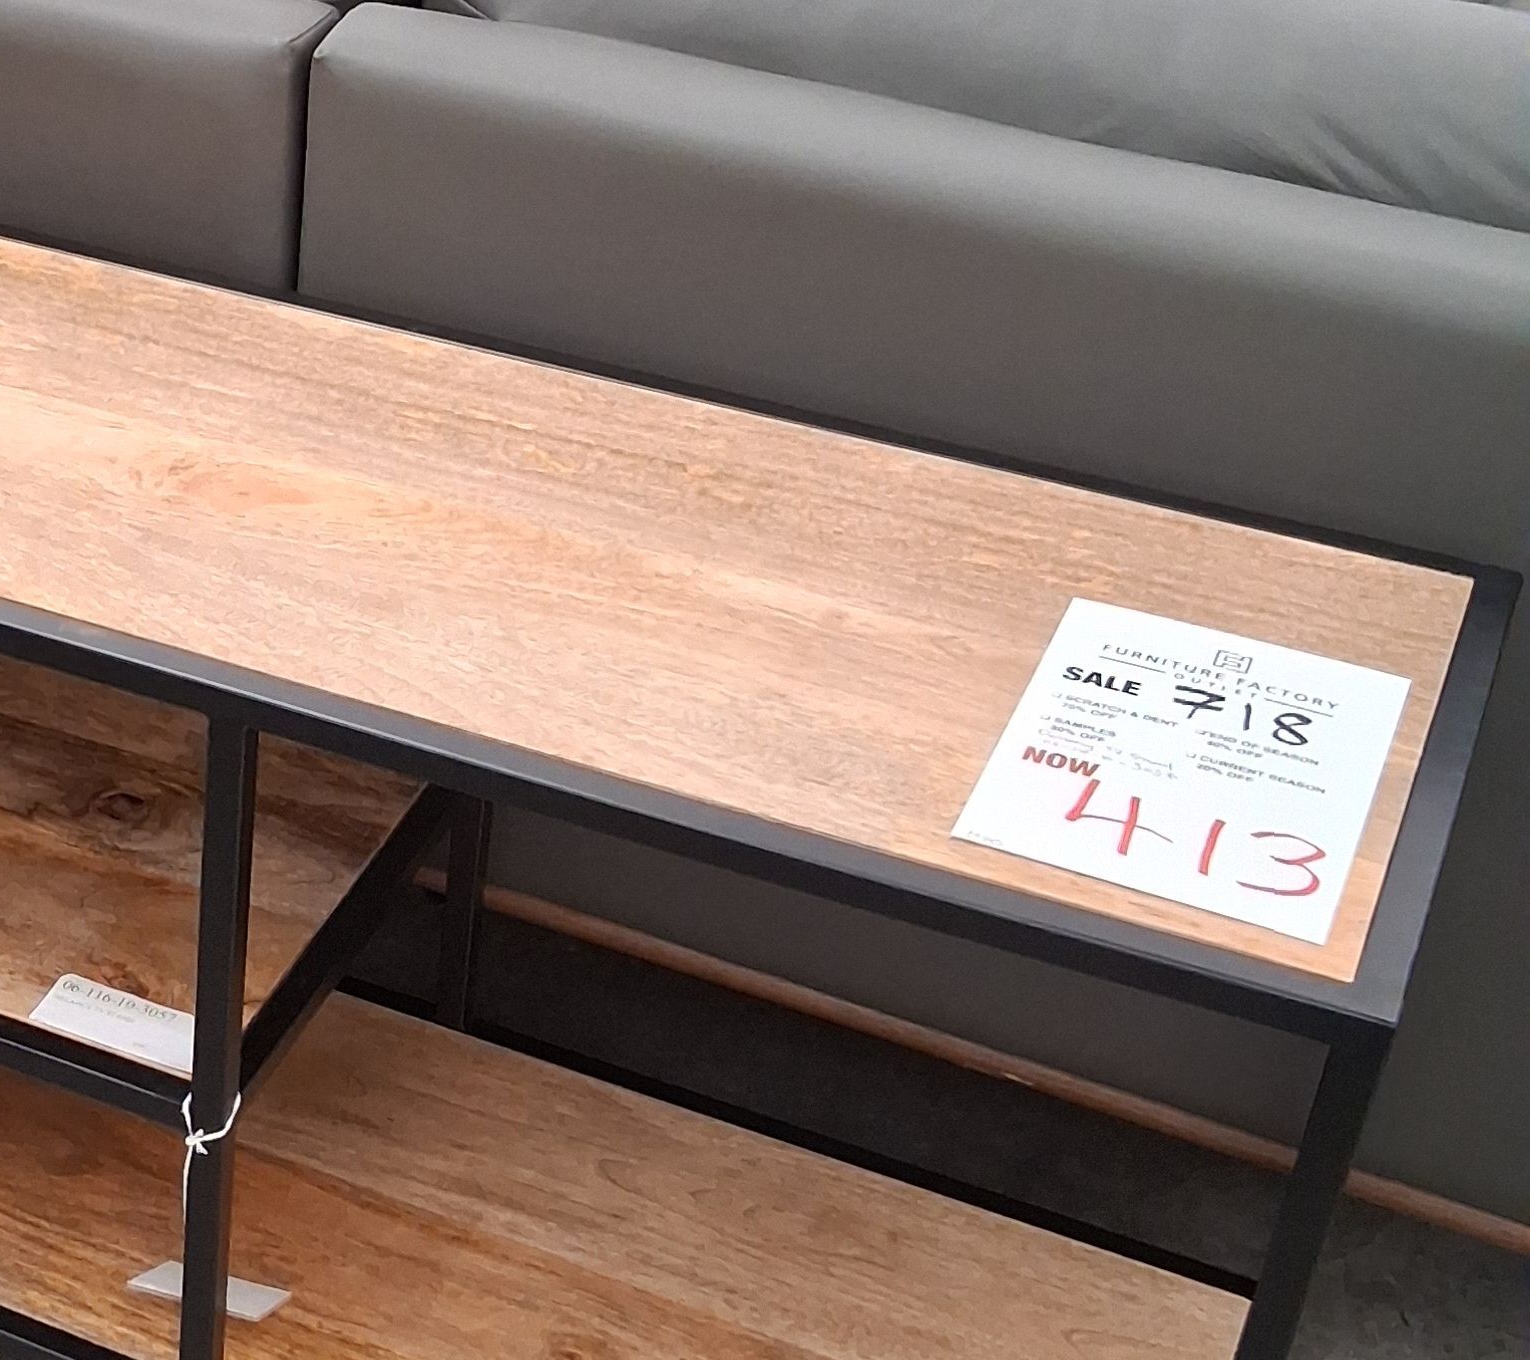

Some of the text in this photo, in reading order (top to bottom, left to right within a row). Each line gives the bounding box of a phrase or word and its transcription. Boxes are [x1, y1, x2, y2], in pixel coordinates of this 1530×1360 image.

[1062, 666, 1142, 696] SALE
[1102, 644, 1340, 710] FURNITURE FACTORY
[1065, 694, 1127, 714] SCRATCH
[1143, 714, 1178, 727] DENT
[1091, 709, 1118, 719] OFF
[1173, 684, 1312, 745] 718
[1054, 717, 1116, 737] SAMPLES
[1080, 732, 1107, 742] OFF
[1021, 746, 1102, 778] NOW
[1236, 748, 1263, 758] OFF
[1241, 740, 1258, 748] OF
[1263, 745, 1319, 766] SEASON
[1200, 755, 1264, 777] CURRENT
[1269, 773, 1326, 794] SEASON
[1227, 771, 1254, 782] OFF
[1064, 778, 1328, 897] 413
